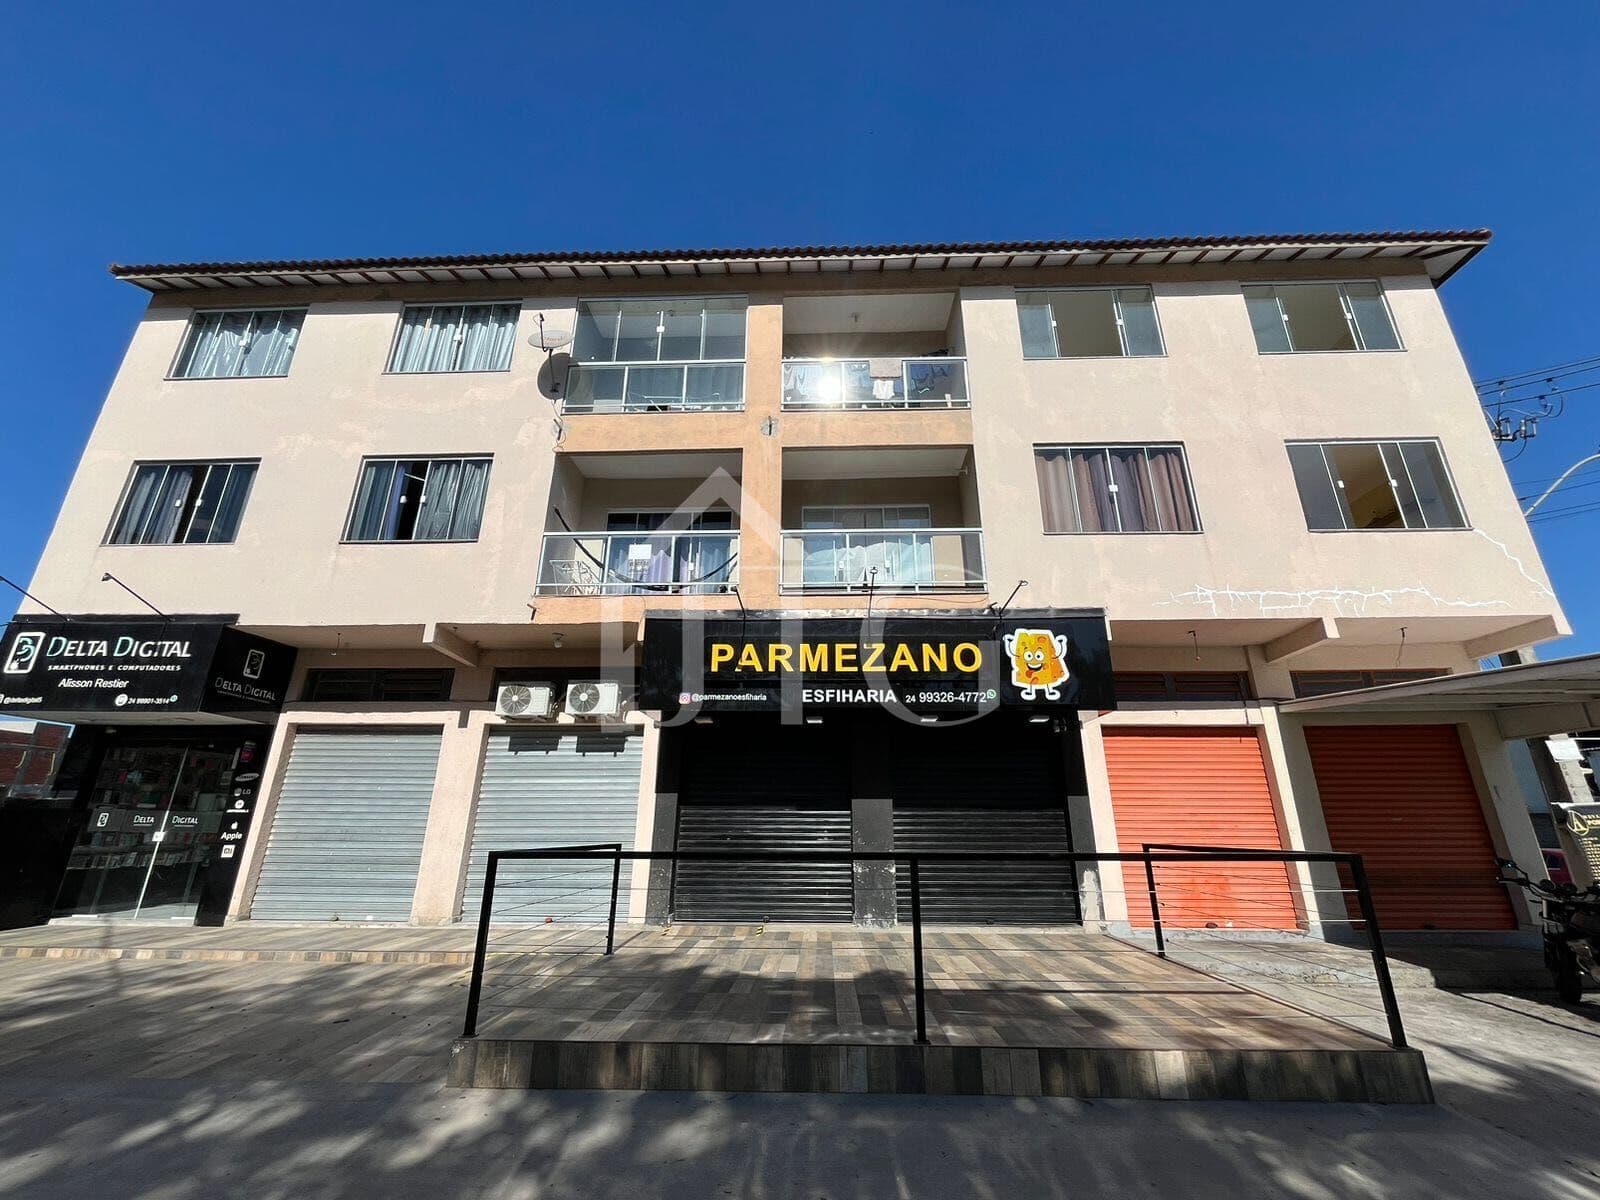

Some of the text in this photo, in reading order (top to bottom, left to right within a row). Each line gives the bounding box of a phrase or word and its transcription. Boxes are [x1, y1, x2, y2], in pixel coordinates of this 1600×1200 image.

[46, 636, 192, 658] DELTA DIGITAL
[710, 642, 983, 673] PARMEZANO
[57, 678, 130, 688] Alisson Restier
[215, 676, 242, 693] DELTA
[244, 683, 276, 701] DIGITAL
[691, 693, 767, 703] @parmezanoesfiharia
[801, 688, 898, 704] ESFIHARIA
[904, 691, 988, 704] 24 99326-4772
[133, 814, 199, 825] DELTA DIGITAL
[220, 831, 243, 841] Apple
